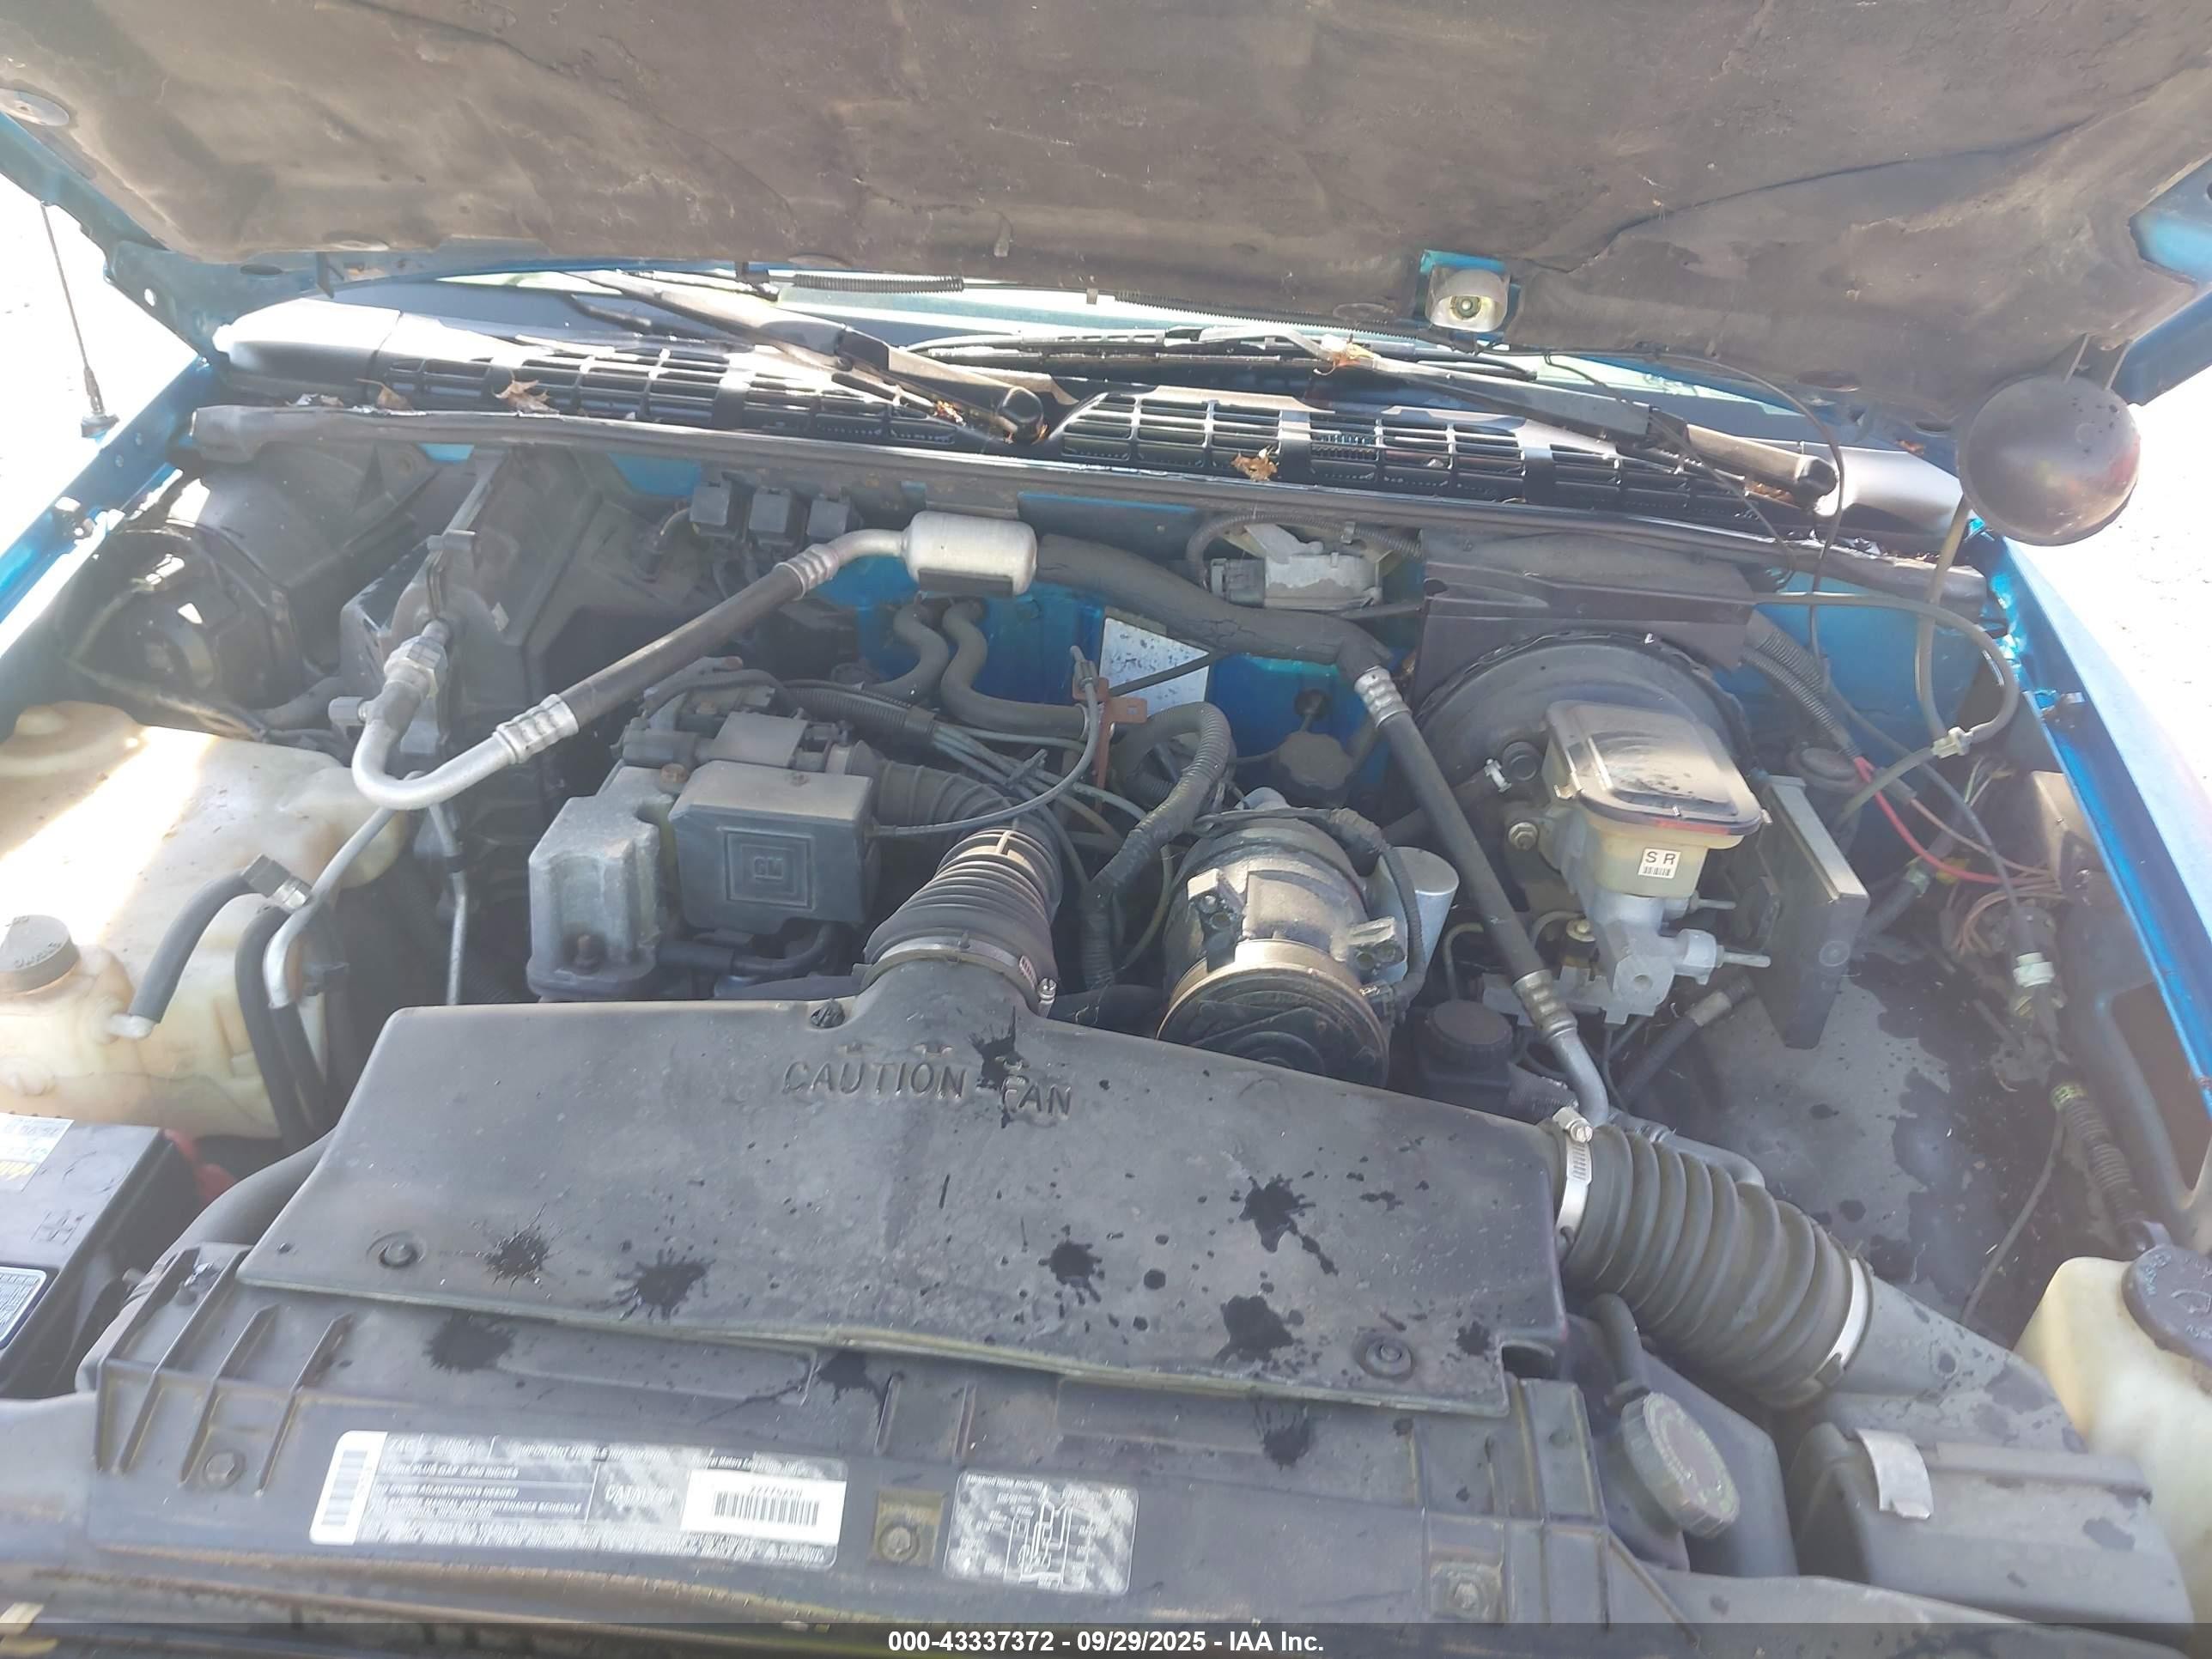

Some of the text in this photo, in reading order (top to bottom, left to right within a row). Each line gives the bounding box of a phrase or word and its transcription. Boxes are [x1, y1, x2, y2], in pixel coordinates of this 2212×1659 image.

[1645, 851, 1676, 865] S R
[781, 1060, 1073, 1120] CAUTION FAN
